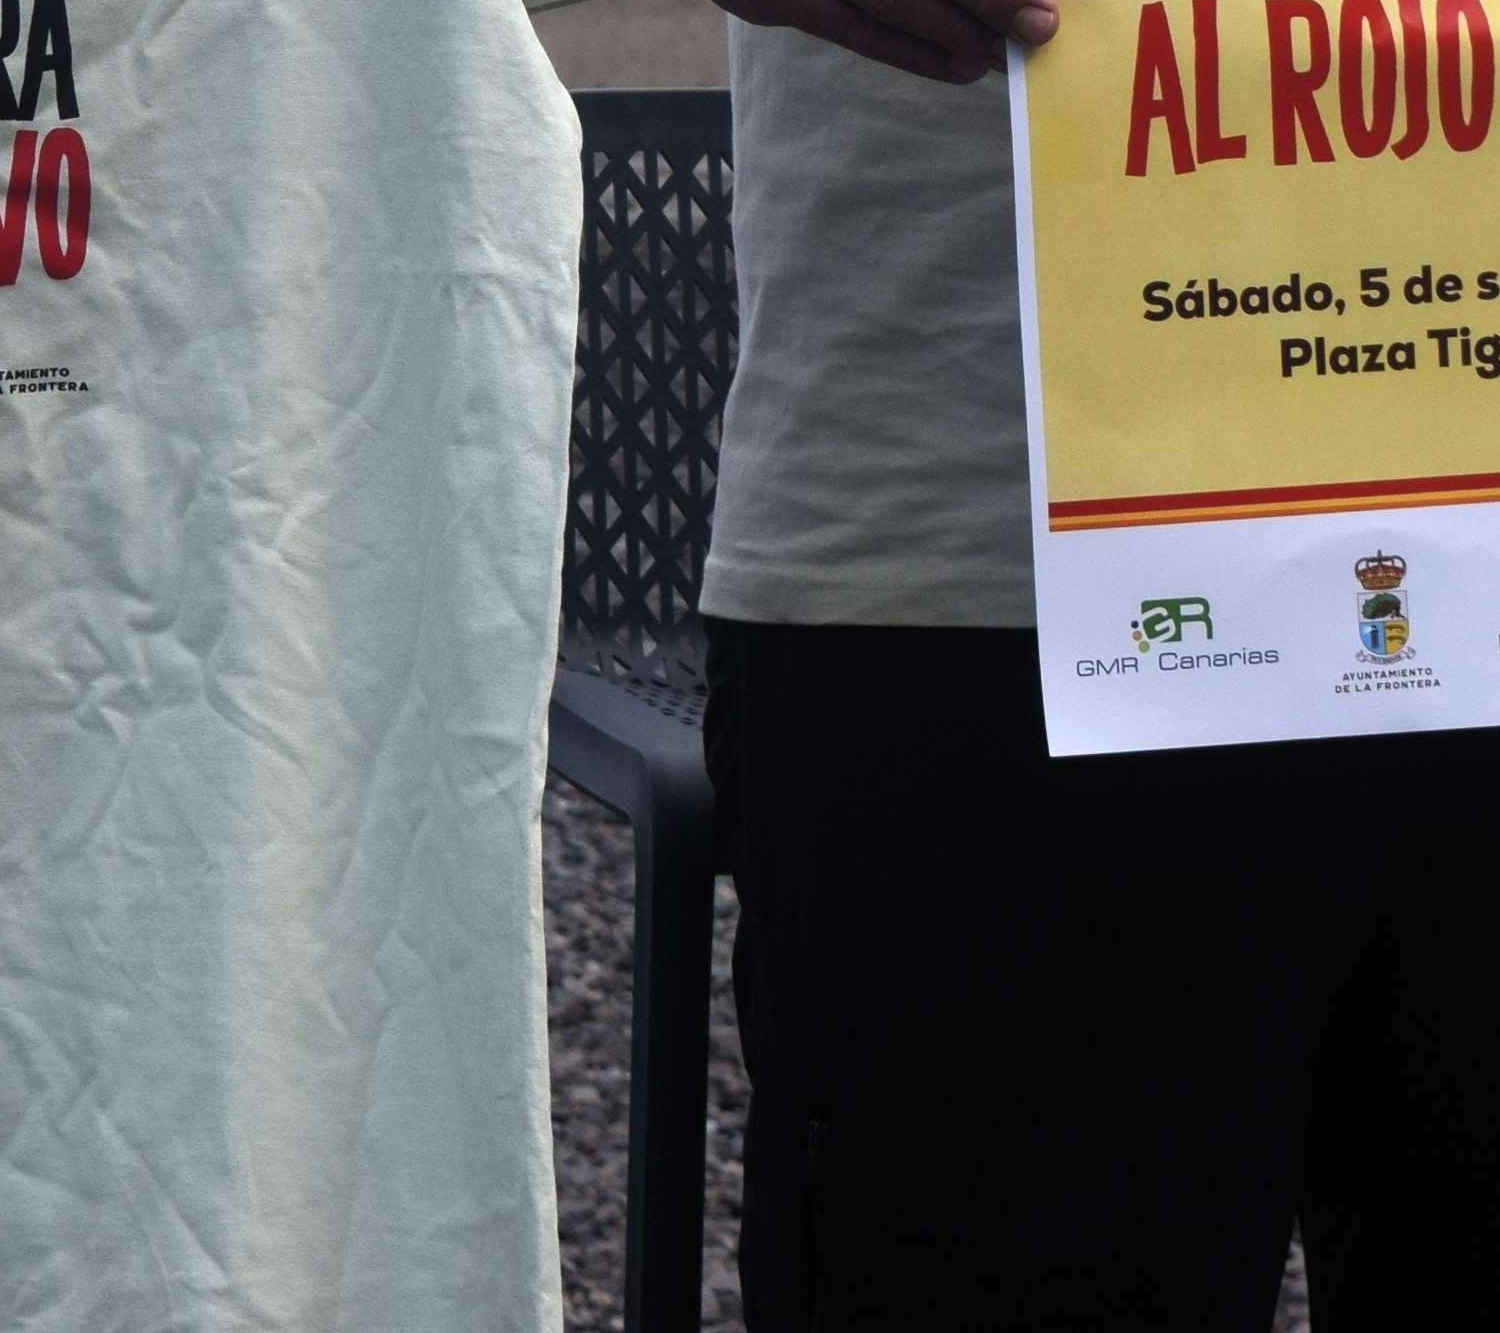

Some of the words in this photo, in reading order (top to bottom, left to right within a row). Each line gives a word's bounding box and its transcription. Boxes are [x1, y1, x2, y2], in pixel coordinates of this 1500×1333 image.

[1142, 272, 1347, 323] Sábado,
[1359, 267, 1389, 308] 5
[1403, 261, 1463, 306] de
[1279, 331, 1417, 378] Plaza
[9, 381, 89, 394] FRONTERA
[1076, 657, 1139, 677] GMR
[1158, 647, 1279, 671] Canarias
[1342, 667, 1432, 681] AYUNTAMIENTO
[1335, 684, 1351, 693] DE
[1355, 683, 1372, 692] LA
[1376, 678, 1441, 691] FRONTERA
